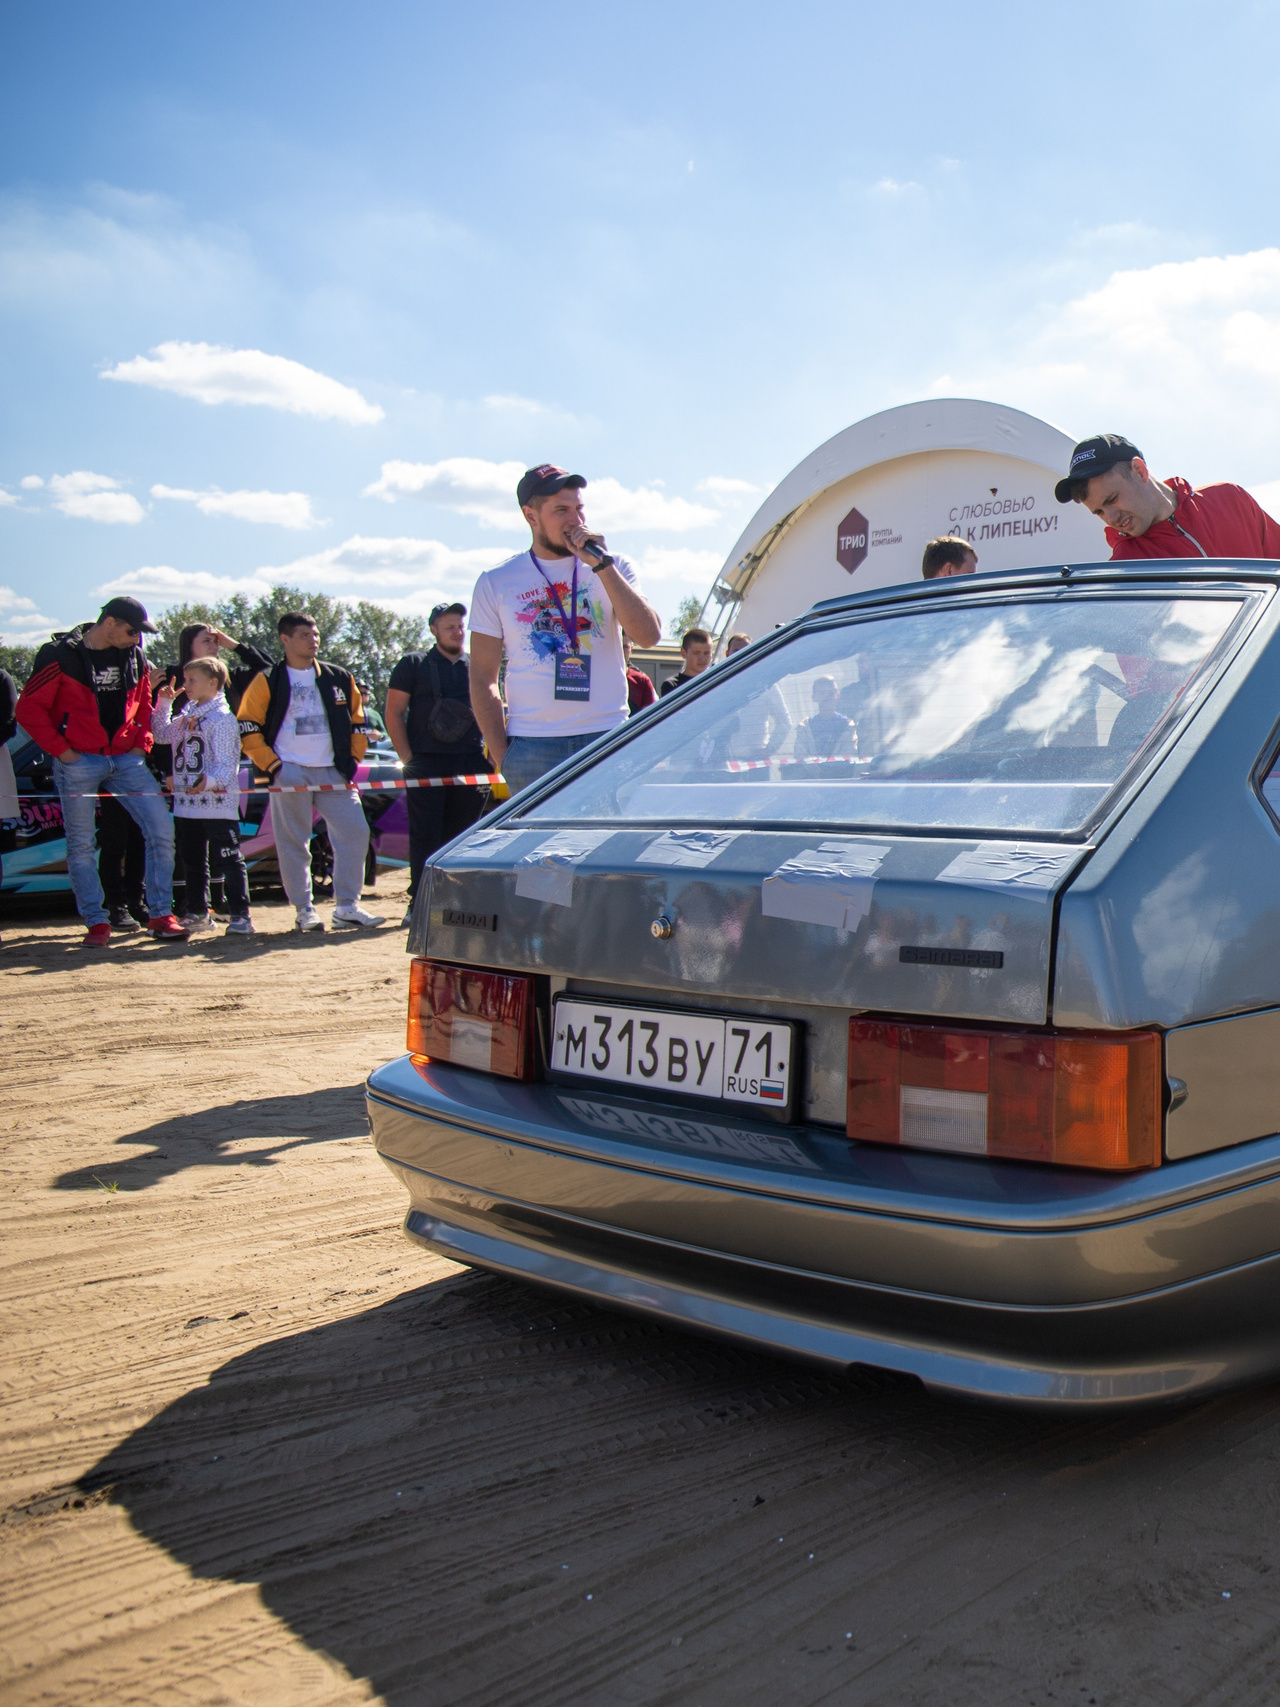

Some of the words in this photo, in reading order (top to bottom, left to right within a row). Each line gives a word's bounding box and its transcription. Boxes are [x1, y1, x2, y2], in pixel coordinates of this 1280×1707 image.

[949, 507, 957, 522] С
[960, 496, 1035, 520] ЛЮБОВЬЮ
[871, 528, 893, 538] ГРУППА
[967, 526, 976, 541] К
[979, 516, 1058, 541] ЛИПЕЦКУ!
[839, 533, 866, 551] ТРИО
[871, 535, 902, 547] КОМПАНИЙ
[521, 588, 540, 600] LOVE
[449, 911, 487, 928] LADA
[565, 1015, 716, 1087] М313ВУ
[731, 1028, 772, 1078] 71
[727, 1076, 758, 1096] RUS
